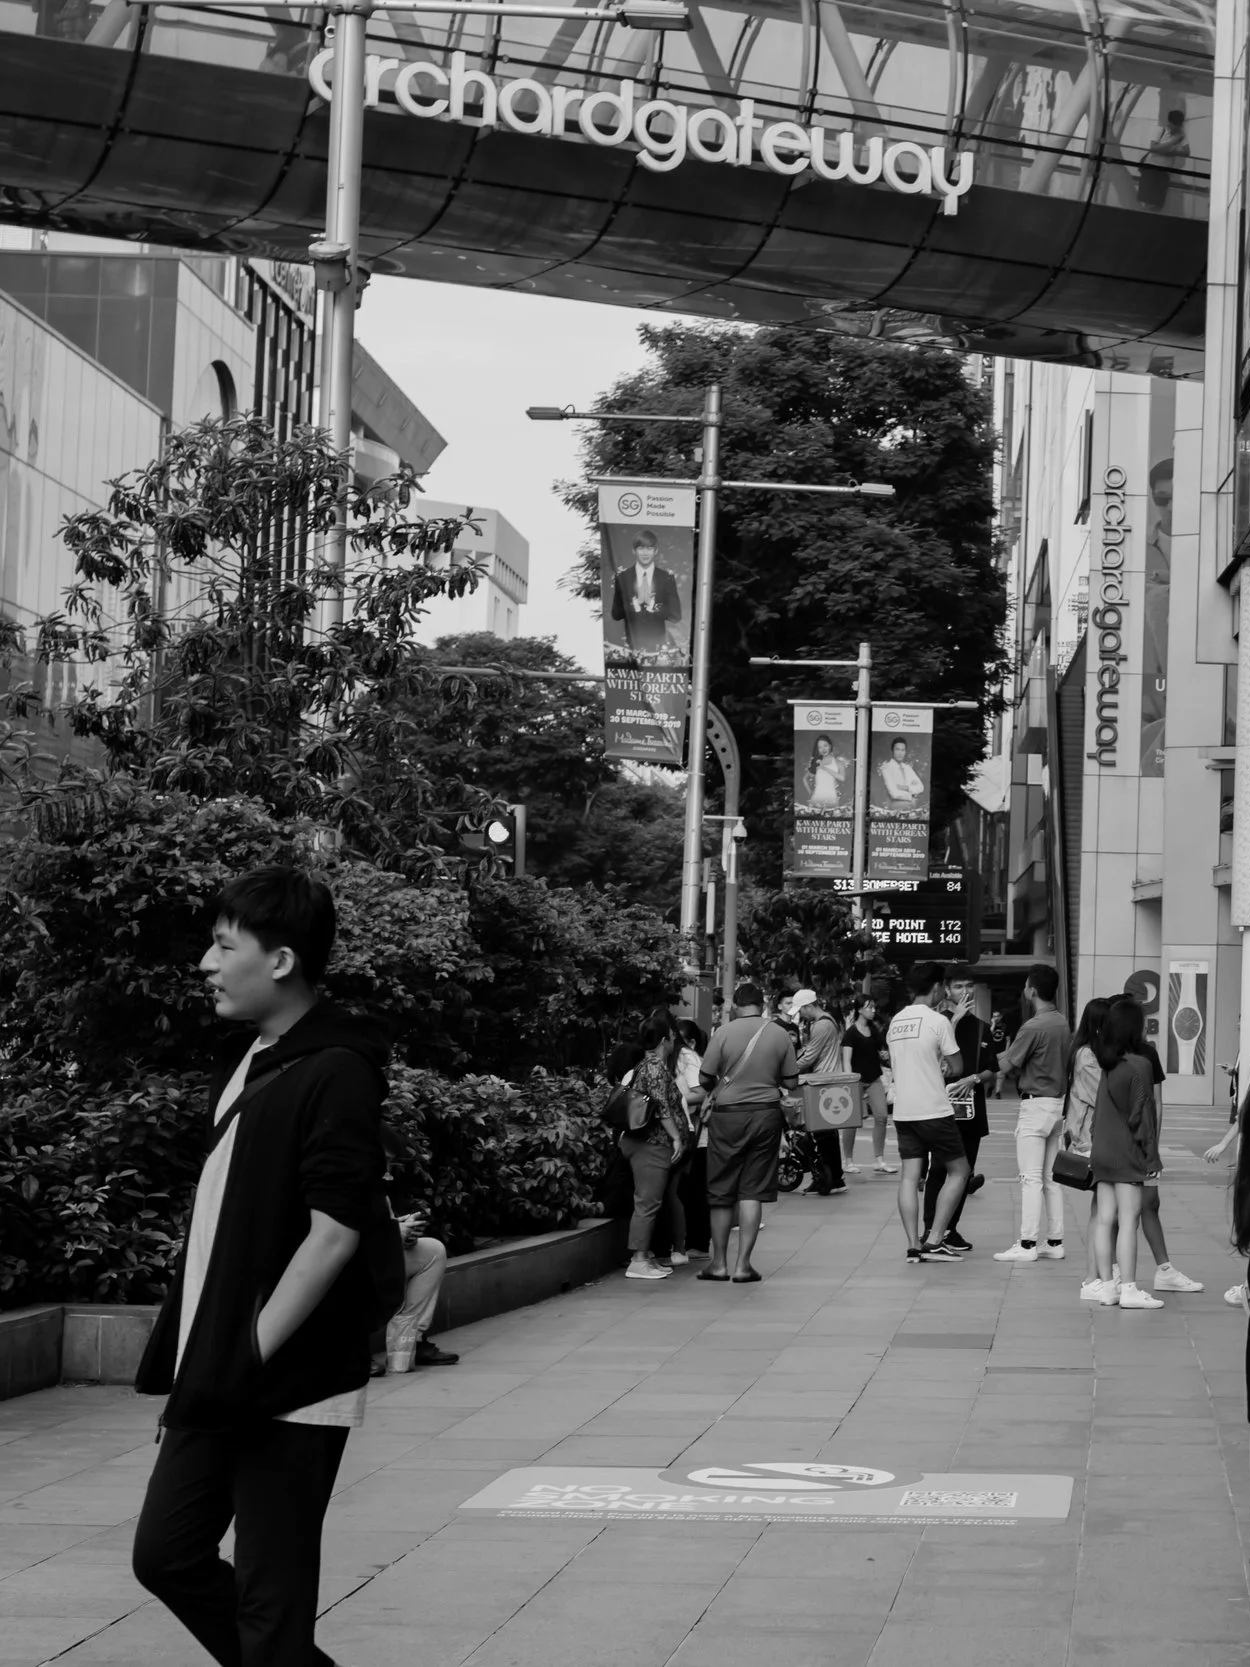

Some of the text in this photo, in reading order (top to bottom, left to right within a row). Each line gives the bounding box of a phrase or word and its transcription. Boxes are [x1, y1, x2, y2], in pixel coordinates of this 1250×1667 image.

[1087, 464, 1131, 767] orchardgateway
[646, 672, 687, 683] PARTY
[606, 679, 685, 694] WITH OREAN
[630, 690, 661, 704] STRS
[621, 716, 662, 726] SEPTEMB
[833, 879, 962, 892] 313 SOMERSET 84
[889, 919, 926, 930] POINT
[940, 920, 962, 931] 172
[896, 932, 933, 943] HOTEL
[940, 933, 961, 943] 140
[529, 1484, 633, 1493] NO
[520, 1492, 835, 1505] SMOKING
[508, 1499, 699, 1511] ZONE
